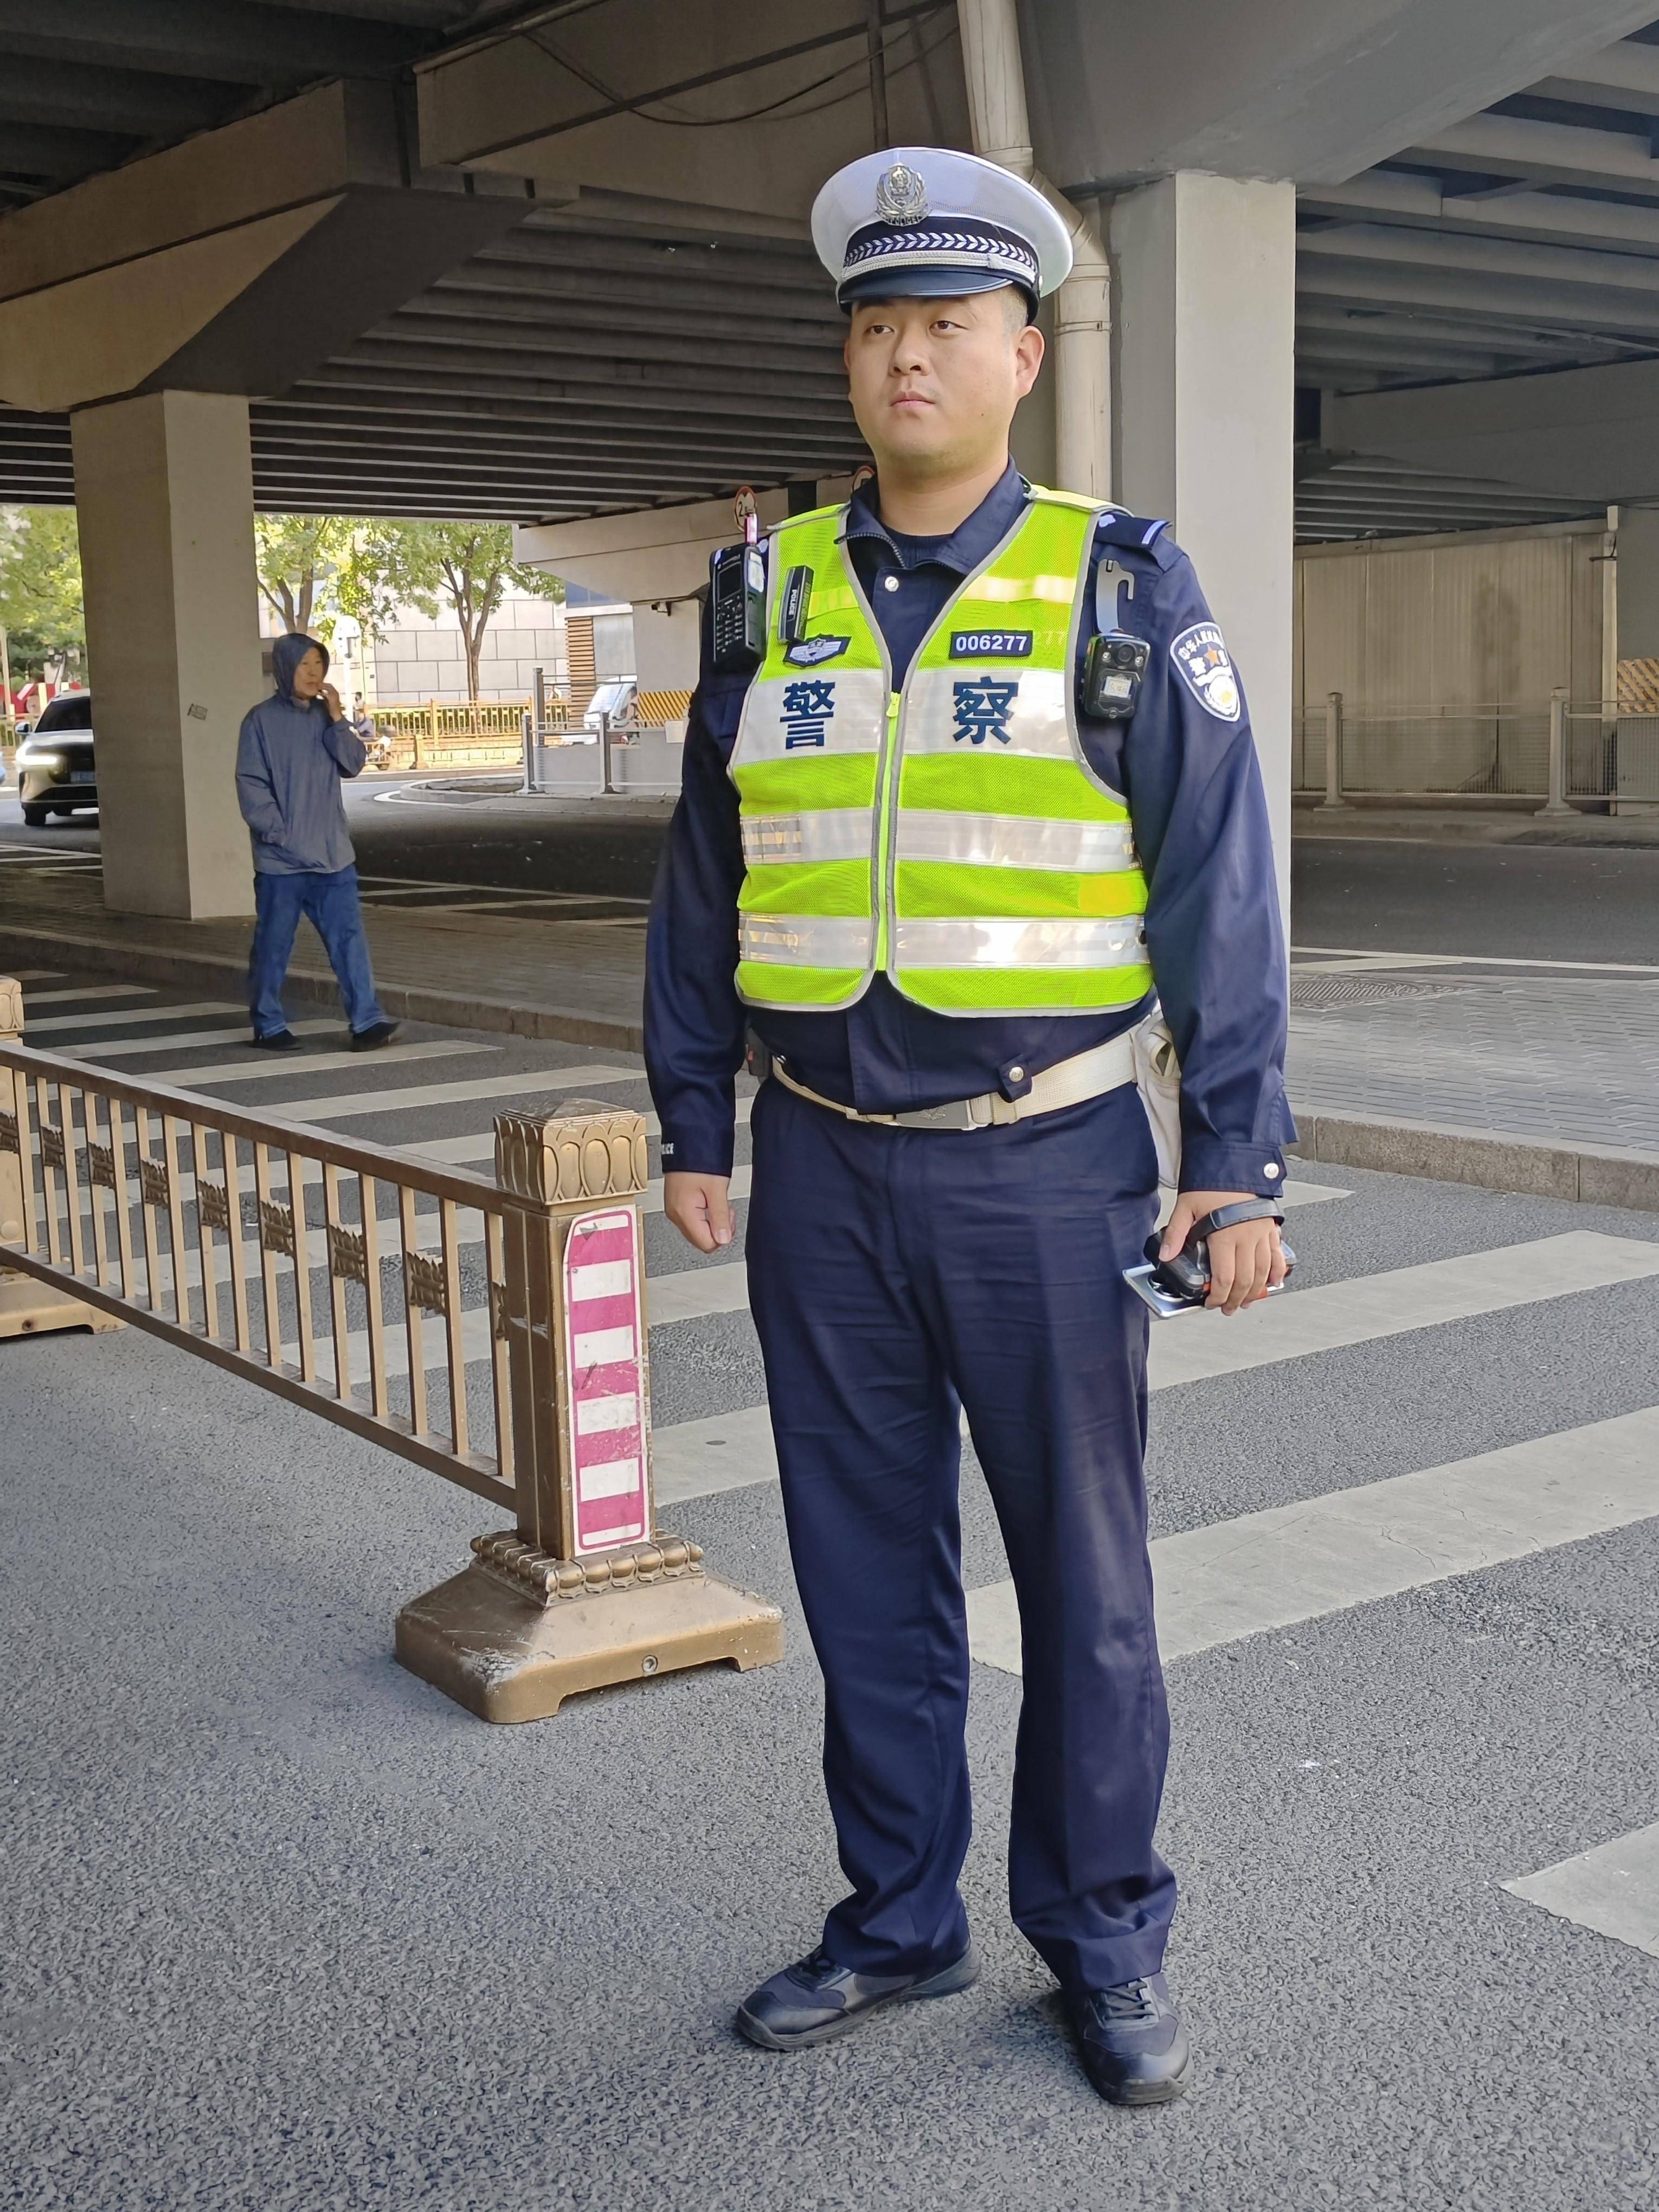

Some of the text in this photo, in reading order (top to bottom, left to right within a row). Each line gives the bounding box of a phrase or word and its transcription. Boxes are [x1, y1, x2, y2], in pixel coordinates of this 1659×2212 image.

[788, 589, 798, 615] POLICE
[955, 634, 1027, 652] 006277
[780, 676, 1019, 750] 警 察
